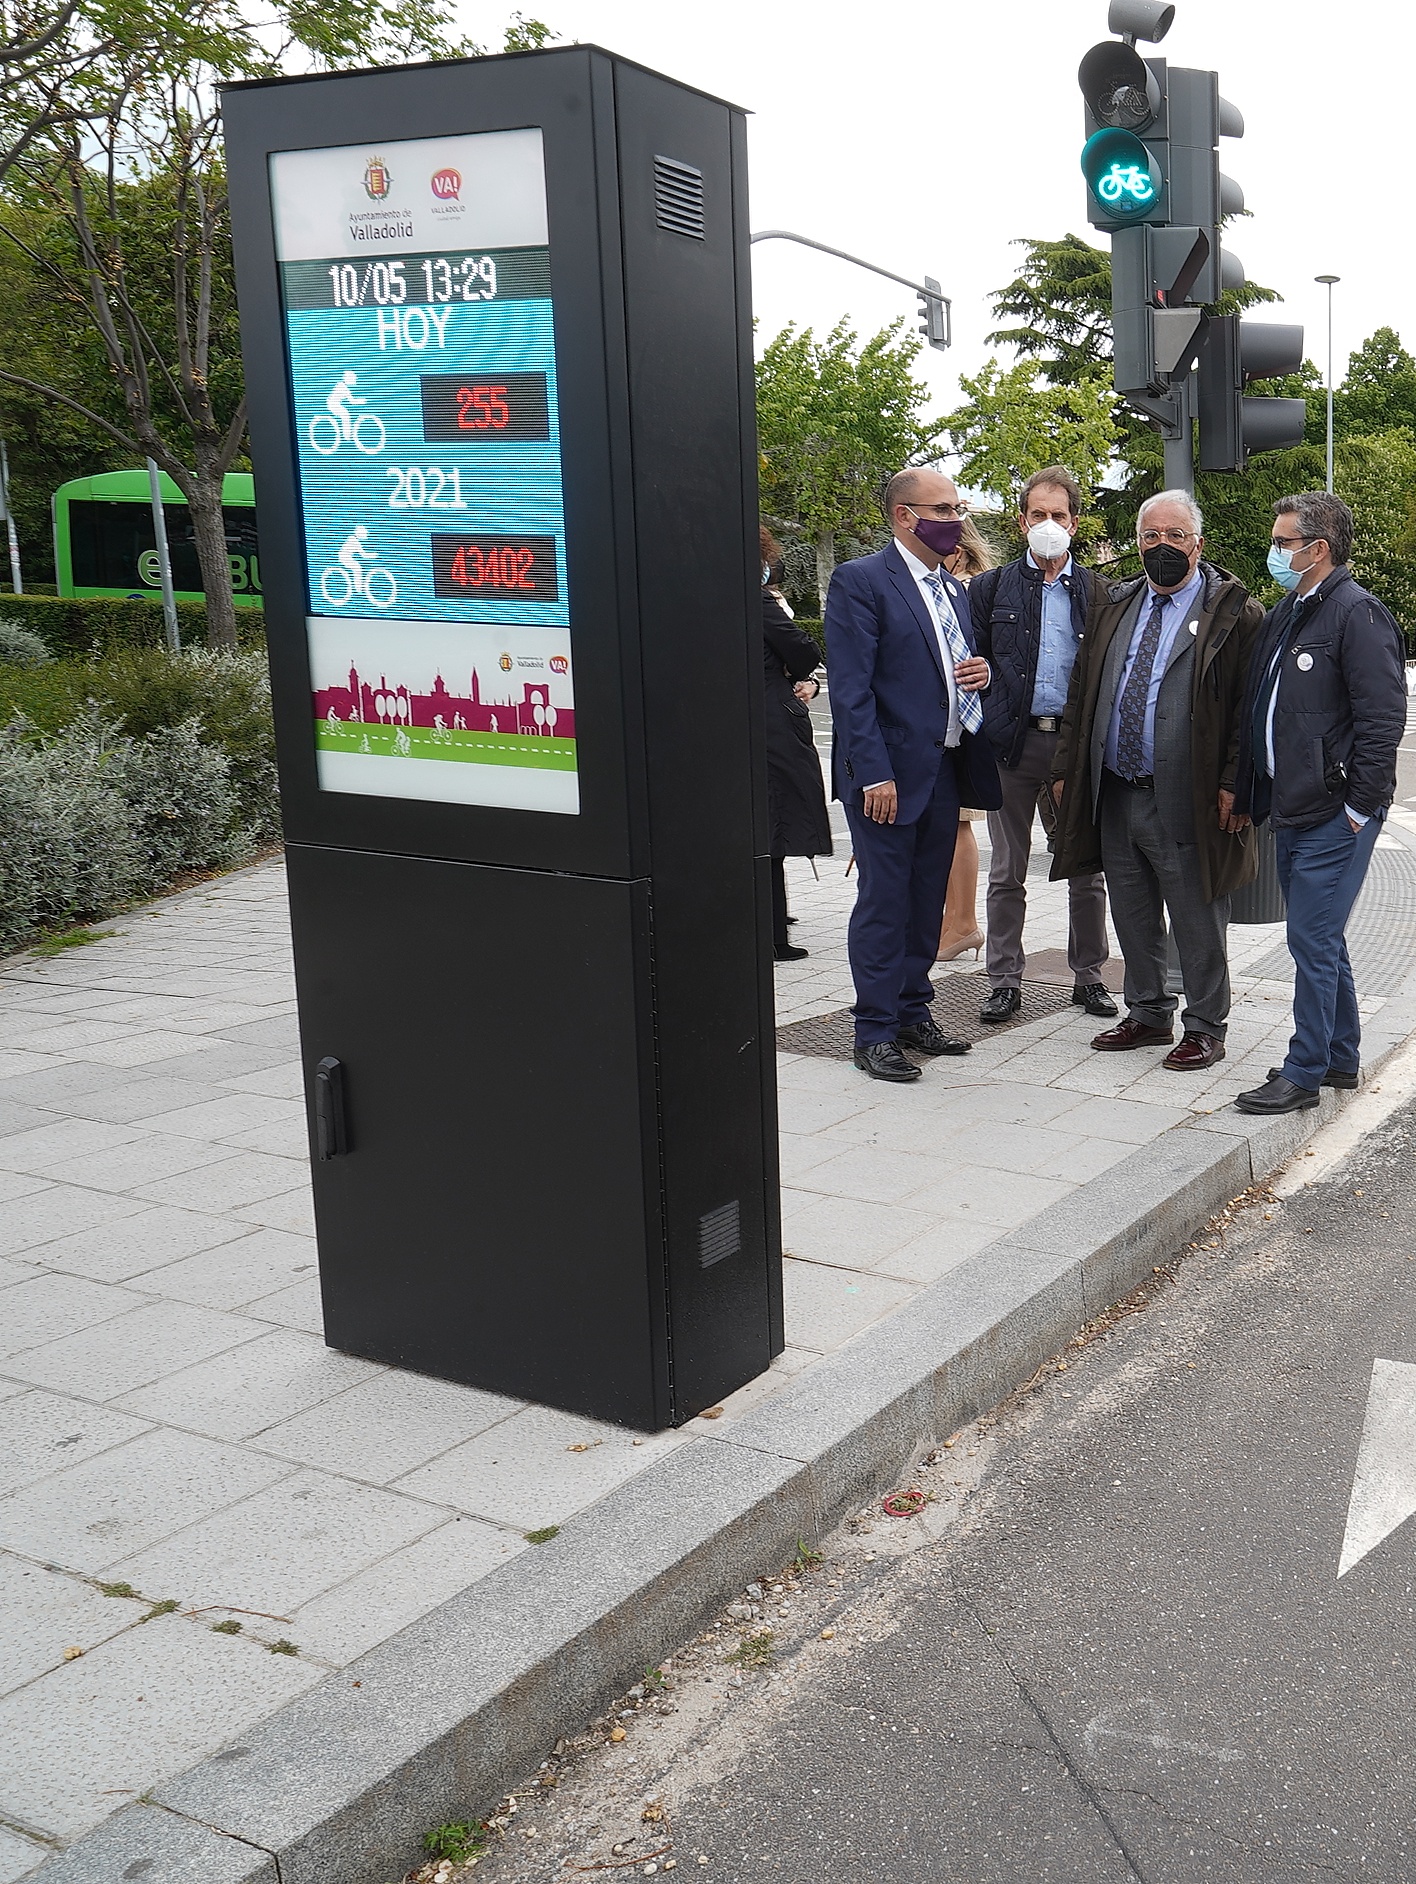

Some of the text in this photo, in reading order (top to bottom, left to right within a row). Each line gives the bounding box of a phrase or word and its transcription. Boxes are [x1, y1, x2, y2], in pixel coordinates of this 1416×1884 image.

[434, 176, 459, 194] VA!
[349, 208, 412, 223] Ayuntamiento de
[350, 222, 413, 241] Valladolid
[329, 256, 497, 306] 10/05 13:29
[377, 307, 452, 350] HOY
[457, 386, 510, 429] 255
[386, 467, 467, 508] 2021
[451, 546, 536, 589] 43402
